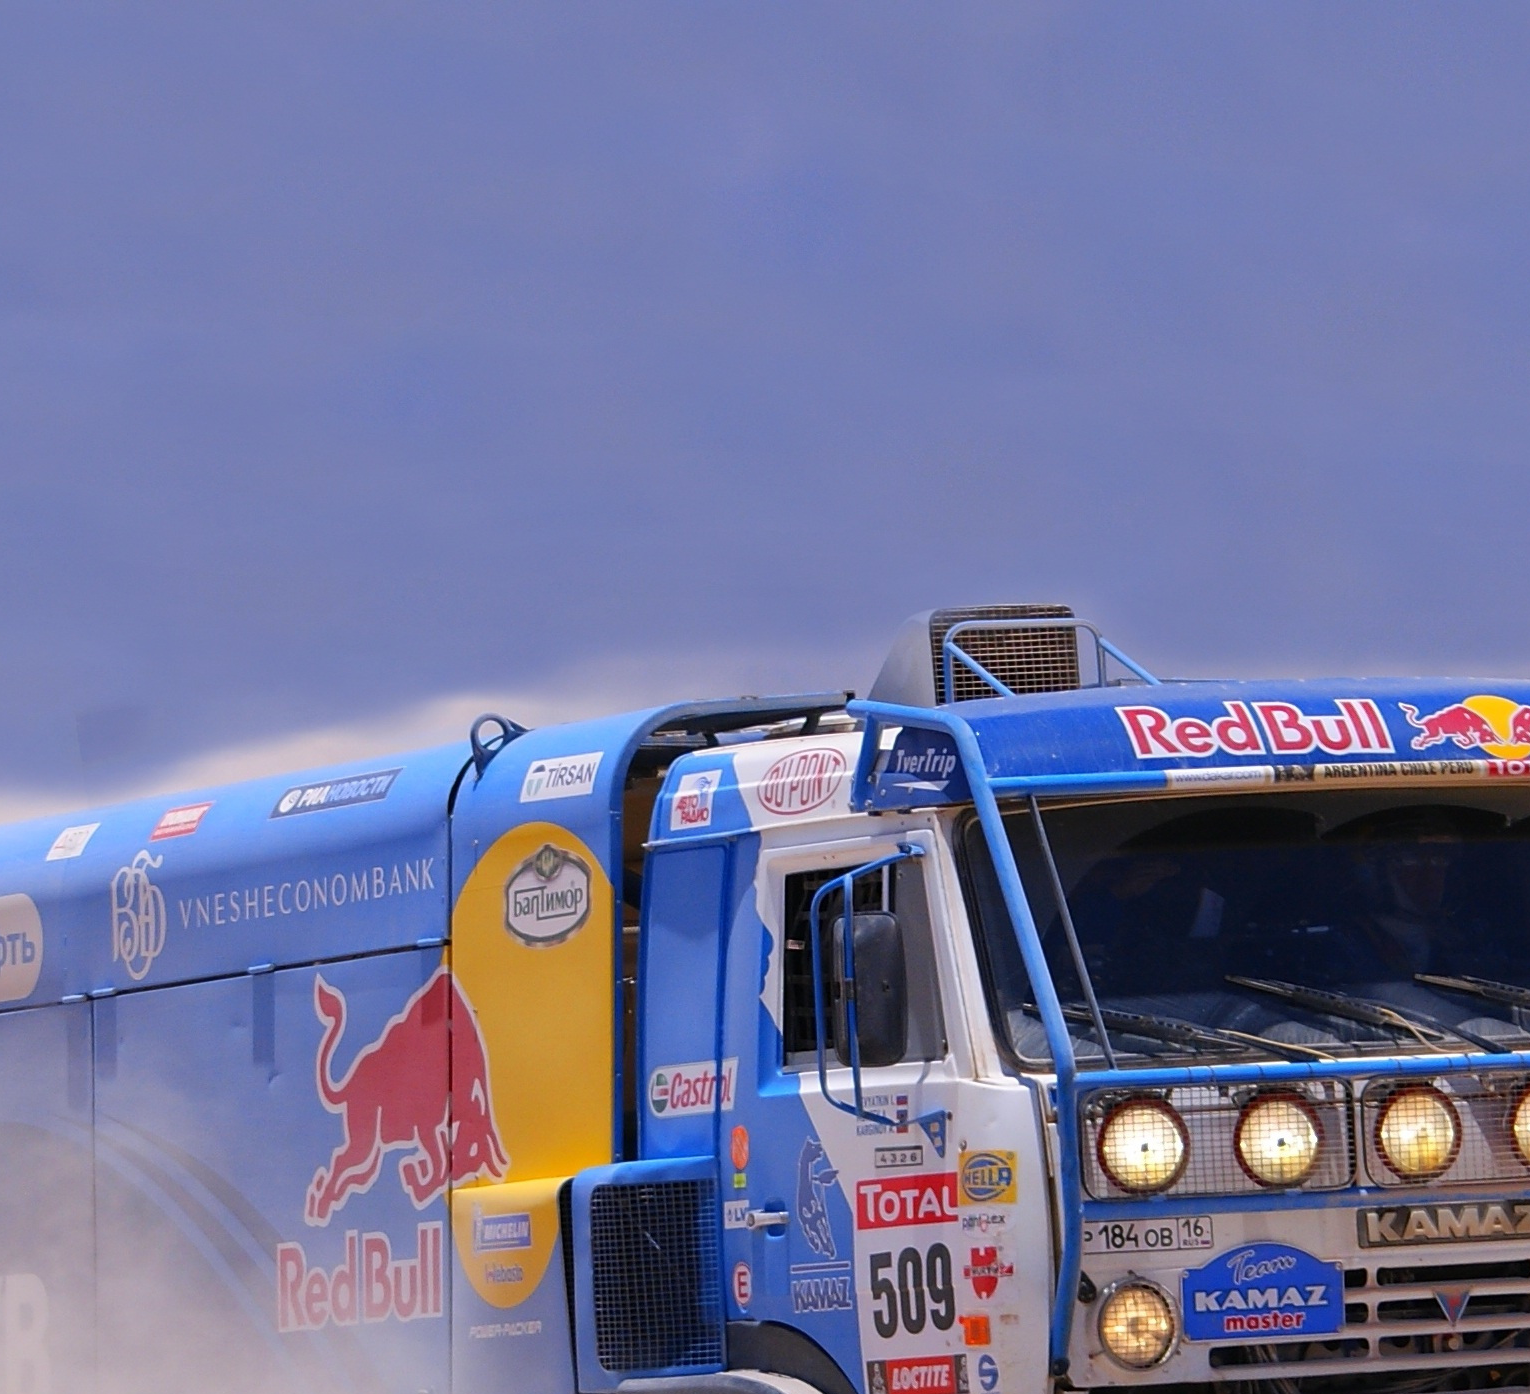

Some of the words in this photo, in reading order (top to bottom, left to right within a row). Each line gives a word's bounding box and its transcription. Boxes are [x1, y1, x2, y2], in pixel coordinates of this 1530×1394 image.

[1115, 701, 1266, 758] Red
[1251, 699, 1395, 754] Bull
[896, 748, 956, 778] TverTrip
[1324, 763, 1397, 778] ARGENTINA
[1401, 762, 1437, 776] CHILE
[1441, 761, 1473, 775] PERU
[179, 857, 434, 929] VNESHECONOMBANK
[671, 1067, 732, 1109] Castrol
[880, 1152, 917, 1163] 4326
[964, 1167, 1012, 1187] HELLA
[860, 1184, 958, 1222] TOTAL
[1182, 1219, 1204, 1237] 16
[278, 1230, 358, 1332] Red
[363, 1221, 443, 1322] Bull
[1227, 1250, 1297, 1285] Team
[738, 1272, 748, 1298] E
[791, 1277, 852, 1313] KAMAZ
[870, 1242, 955, 1338] 509
[1194, 1285, 1328, 1312] KAMAZ
[1224, 1311, 1305, 1332] master
[892, 1364, 949, 1390] LOCTITE
